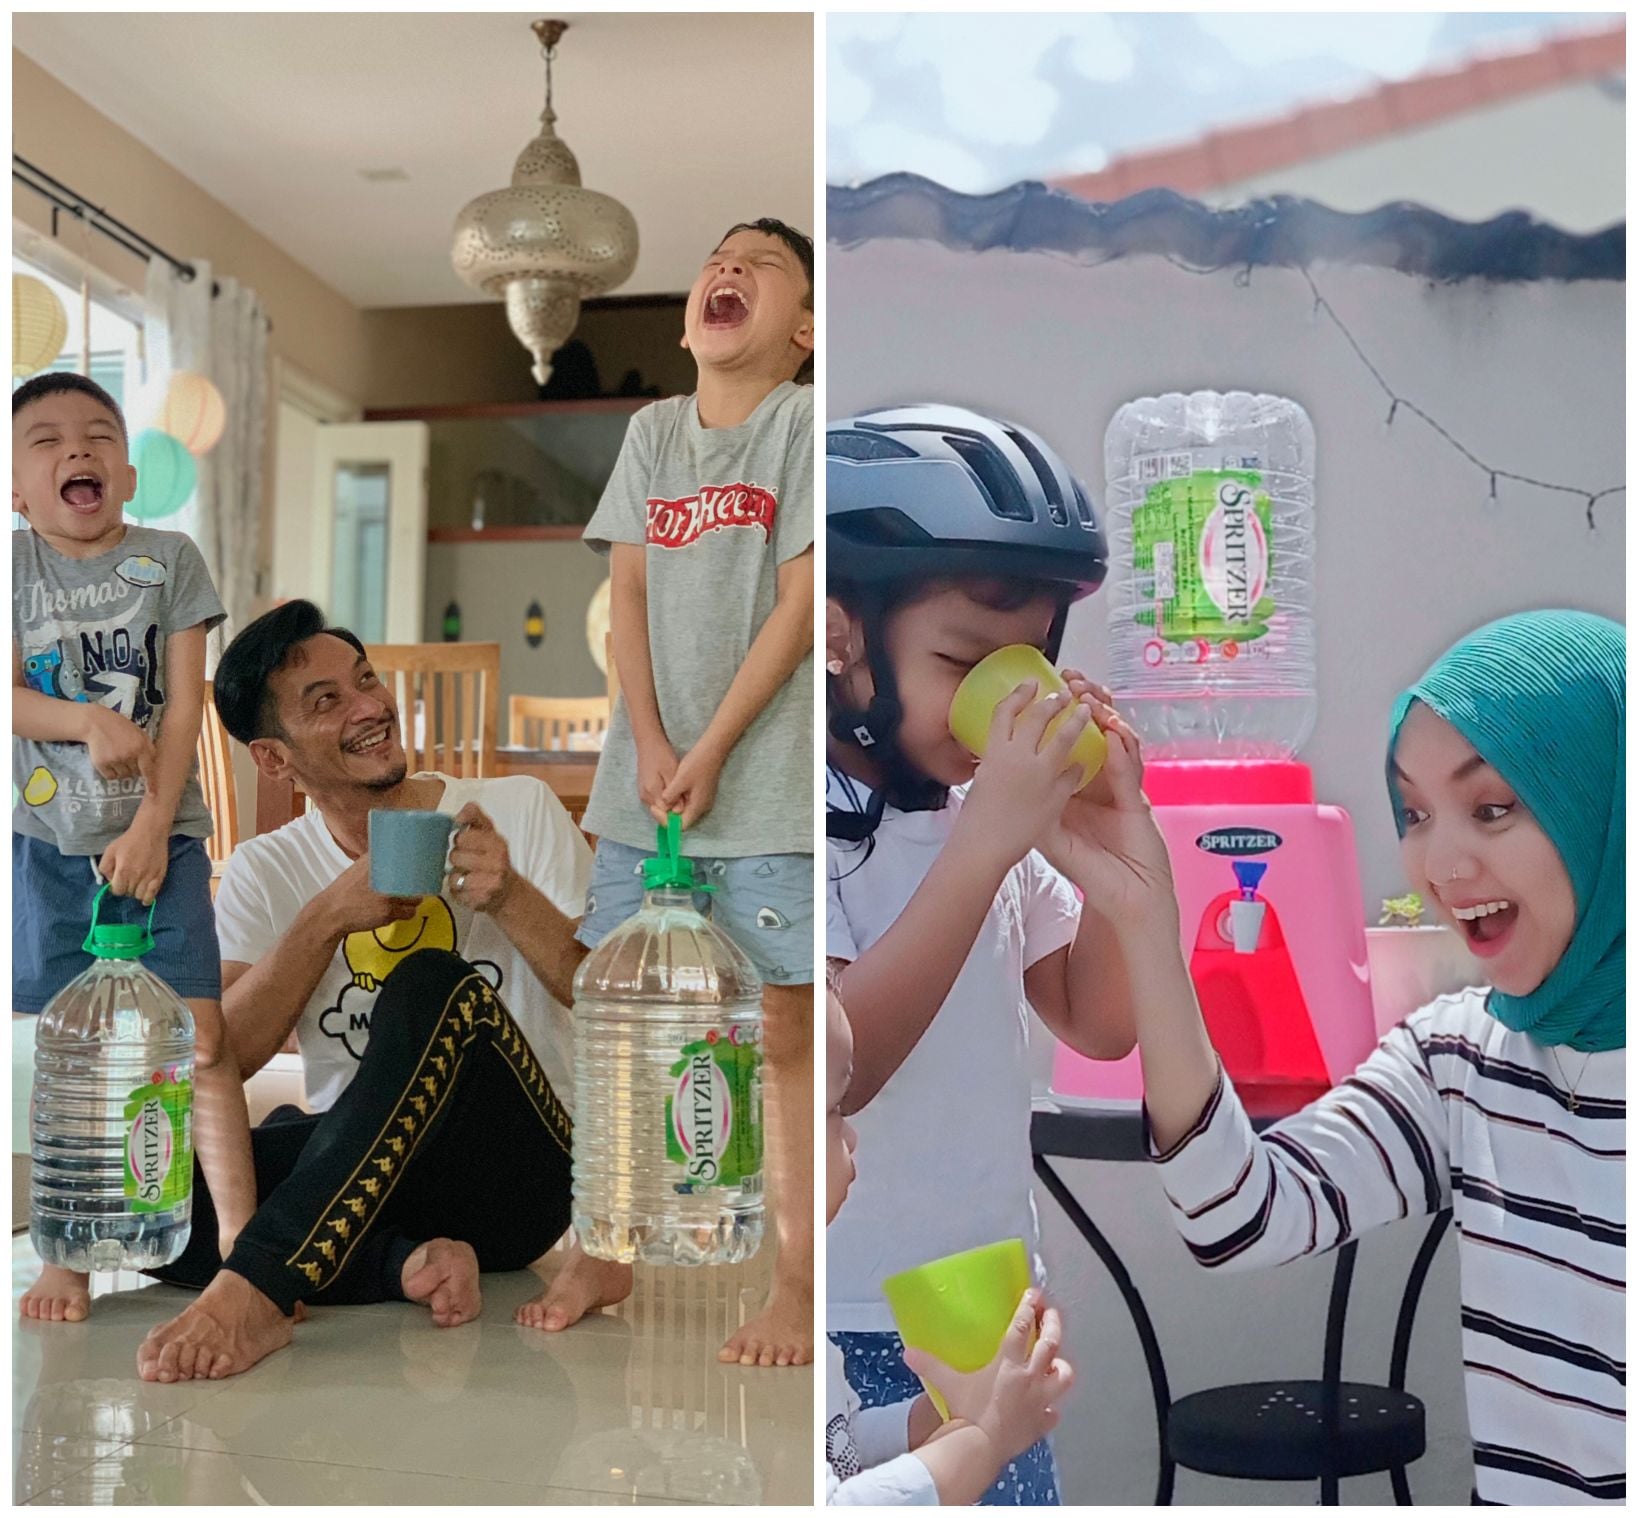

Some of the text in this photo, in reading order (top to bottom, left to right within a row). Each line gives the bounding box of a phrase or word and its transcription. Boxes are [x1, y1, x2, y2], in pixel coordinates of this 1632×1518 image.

[15, 579, 130, 623] Thomas
[1219, 484, 1250, 621] SPRITZER
[1200, 834, 1277, 851] SPRITZER
[140, 1100, 161, 1201] SPRITZER
[689, 1054, 717, 1181] SPRITZER
